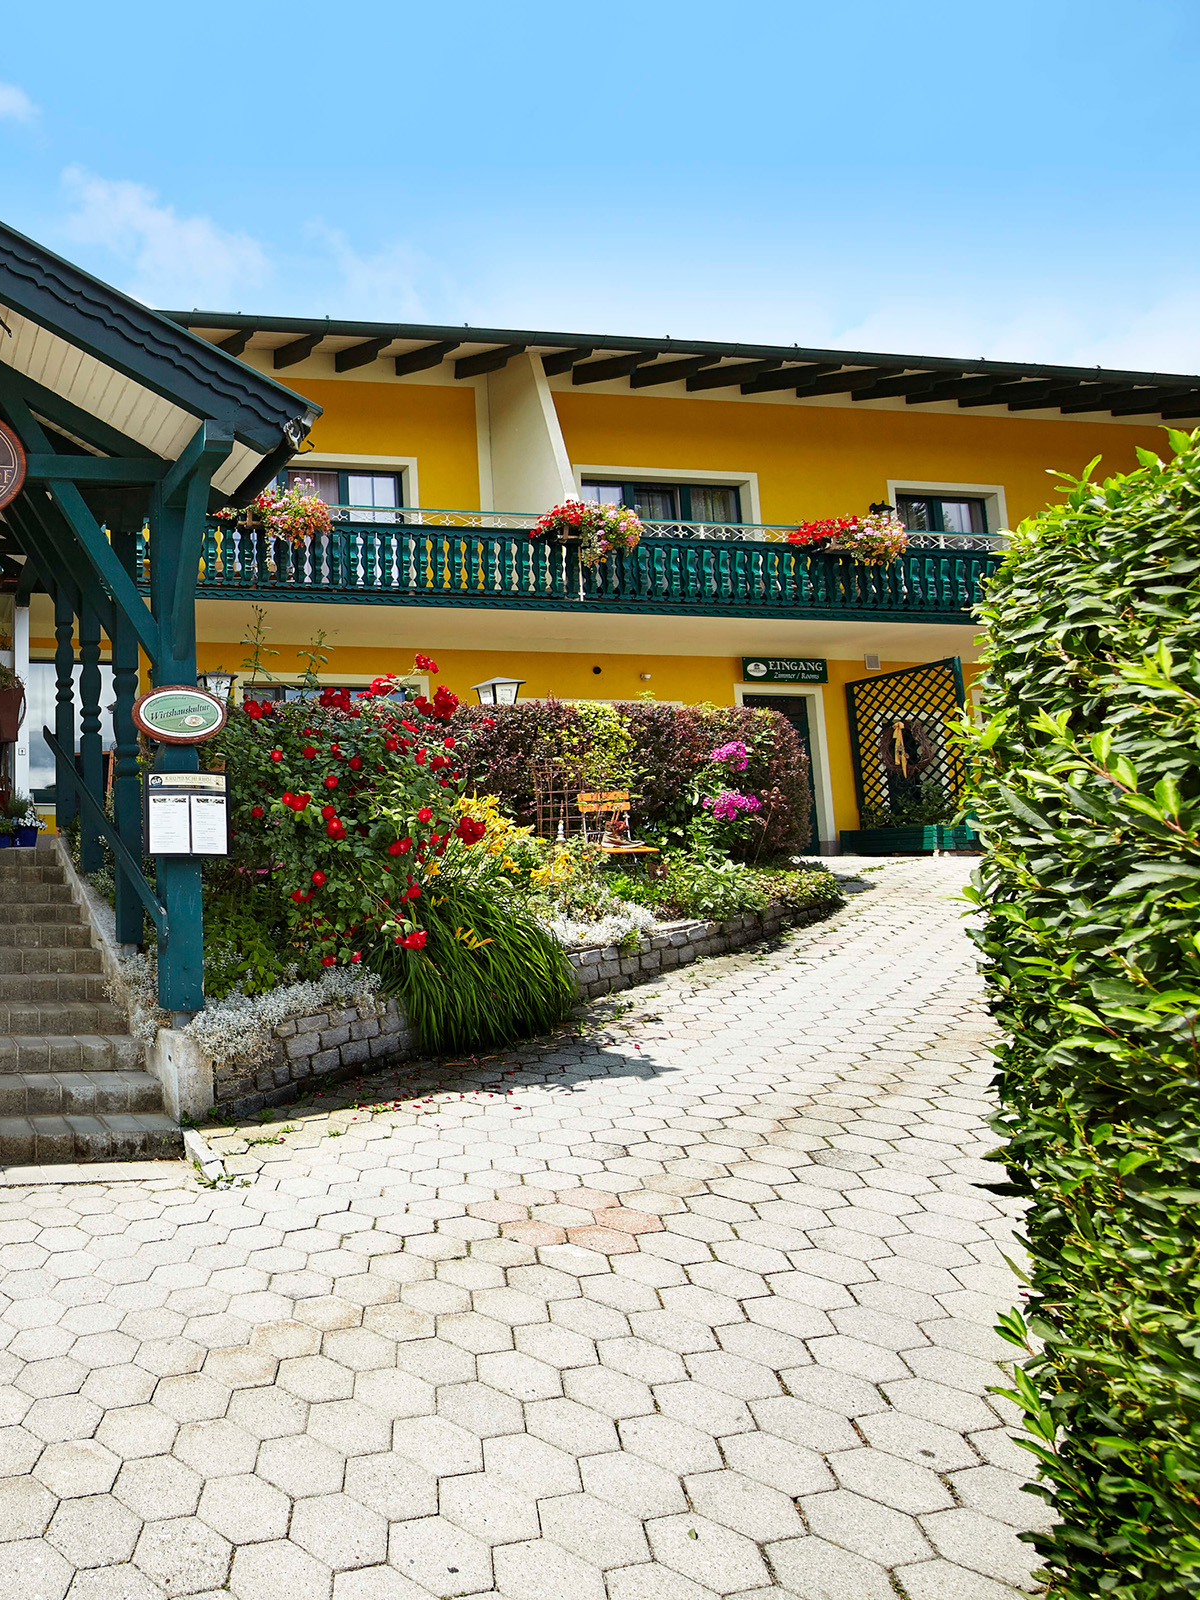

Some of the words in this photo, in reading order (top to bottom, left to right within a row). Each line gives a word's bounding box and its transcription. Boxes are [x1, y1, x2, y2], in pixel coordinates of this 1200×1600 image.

[768, 661, 823, 671] EINGANG
[801, 672, 820, 680] Rooms
[150, 704, 211, 721] Wirtshauskultur
